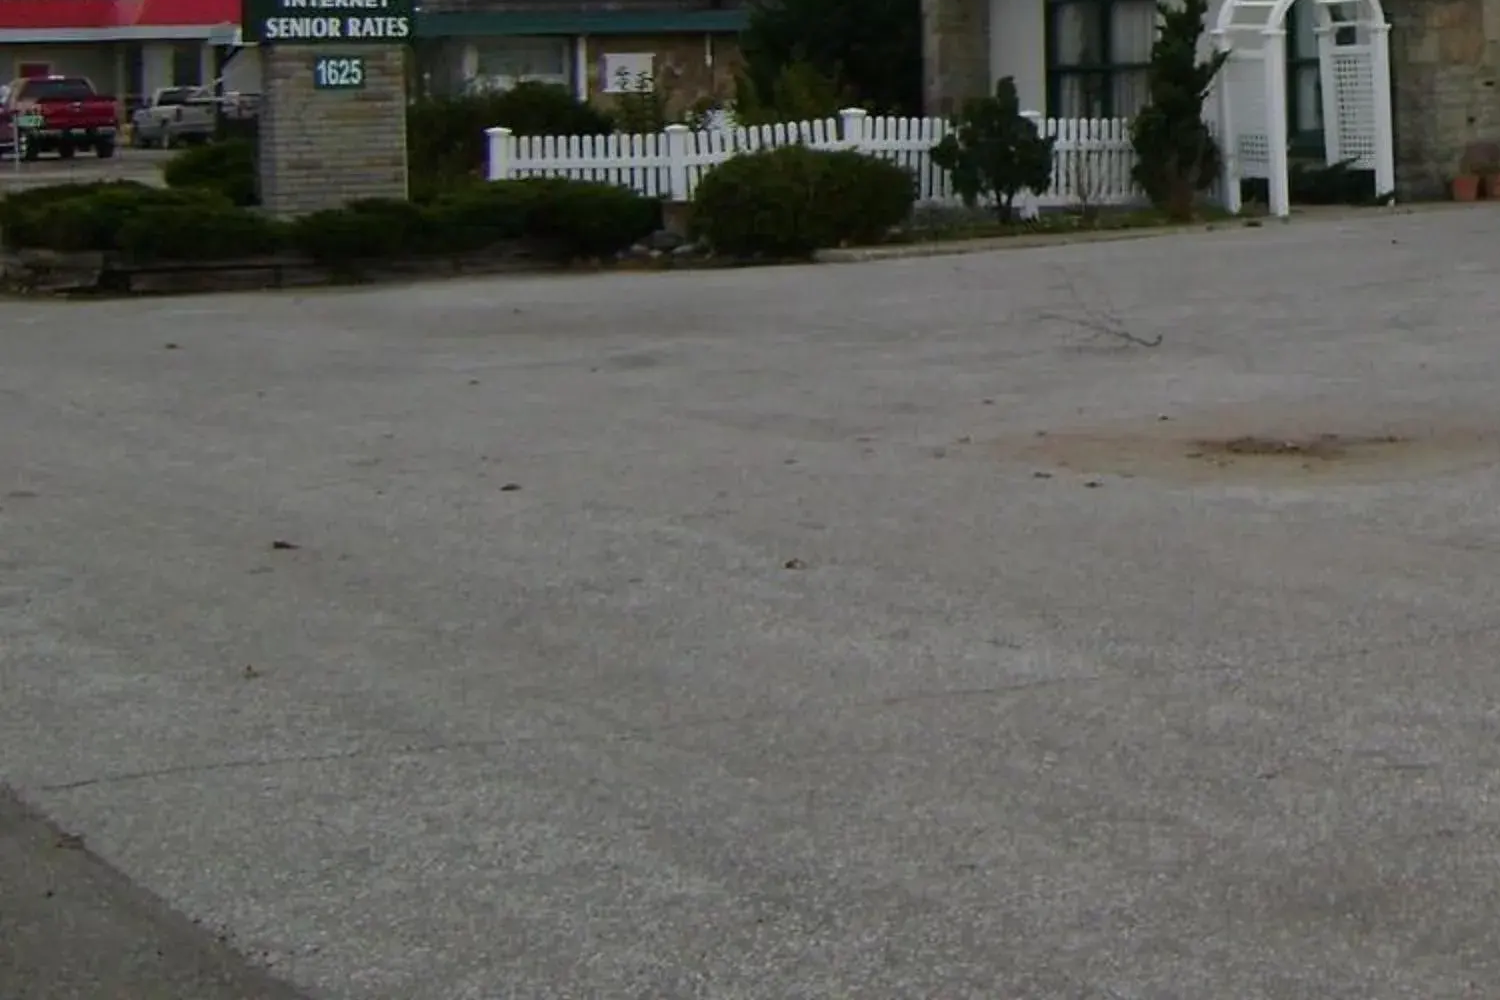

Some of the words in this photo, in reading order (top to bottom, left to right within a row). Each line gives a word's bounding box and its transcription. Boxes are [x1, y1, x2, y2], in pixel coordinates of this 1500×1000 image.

[266, 17, 342, 38] SENIOR
[347, 17, 409, 37] RATES
[317, 59, 363, 85] 1625
